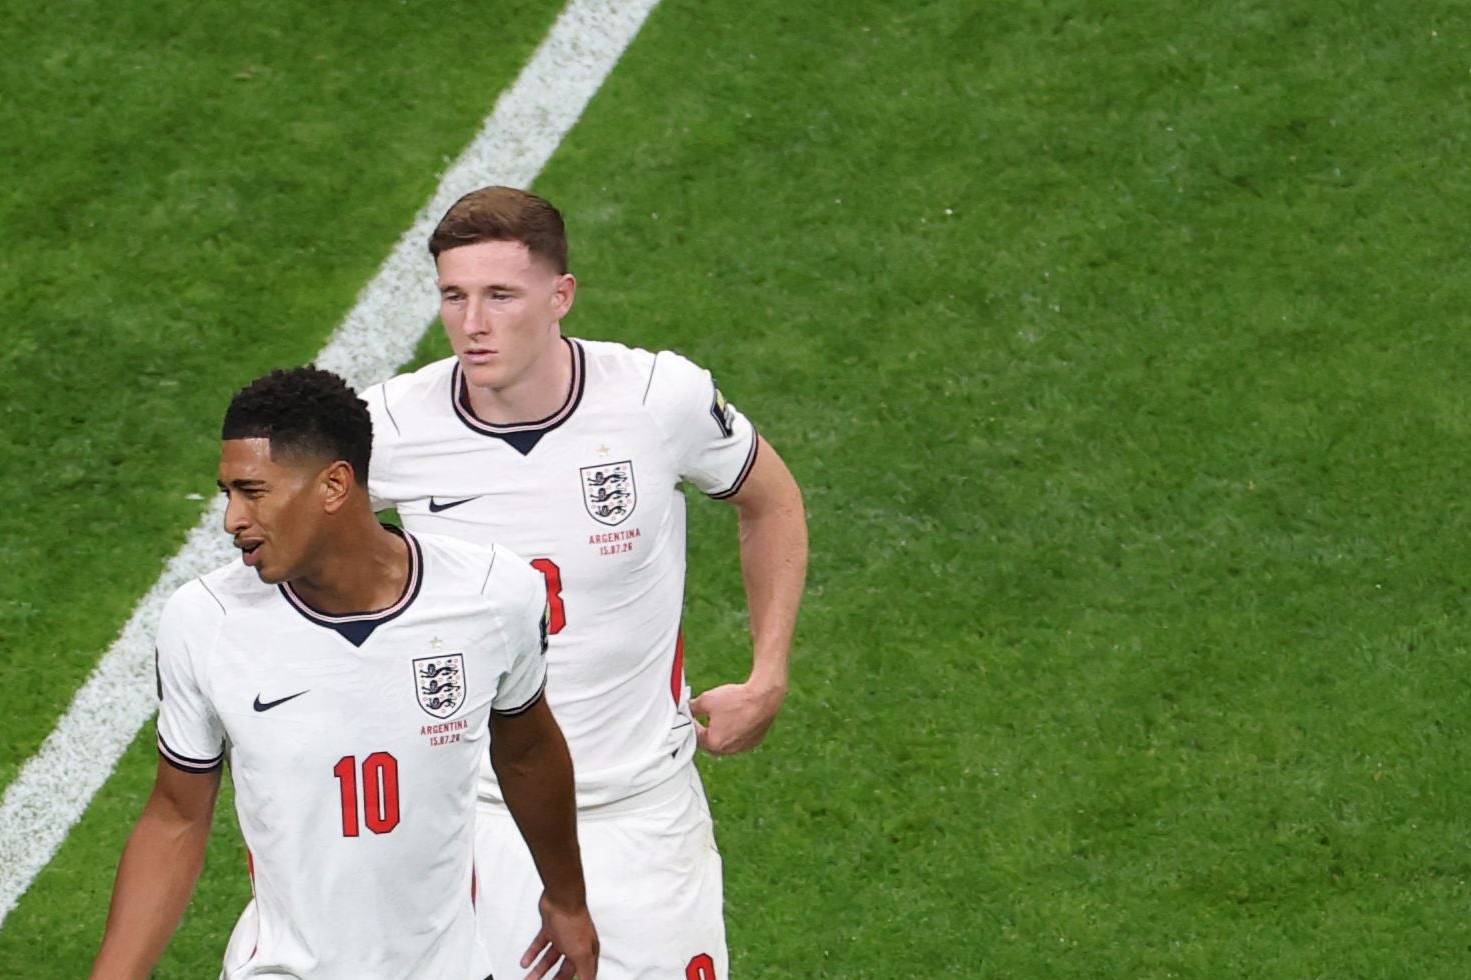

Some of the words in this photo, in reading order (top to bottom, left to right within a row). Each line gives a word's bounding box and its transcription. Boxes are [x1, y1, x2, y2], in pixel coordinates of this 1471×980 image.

[589, 528, 641, 544] ARGENTINA
[420, 719, 468, 736] ARGENTINA
[333, 750, 400, 838] 10
